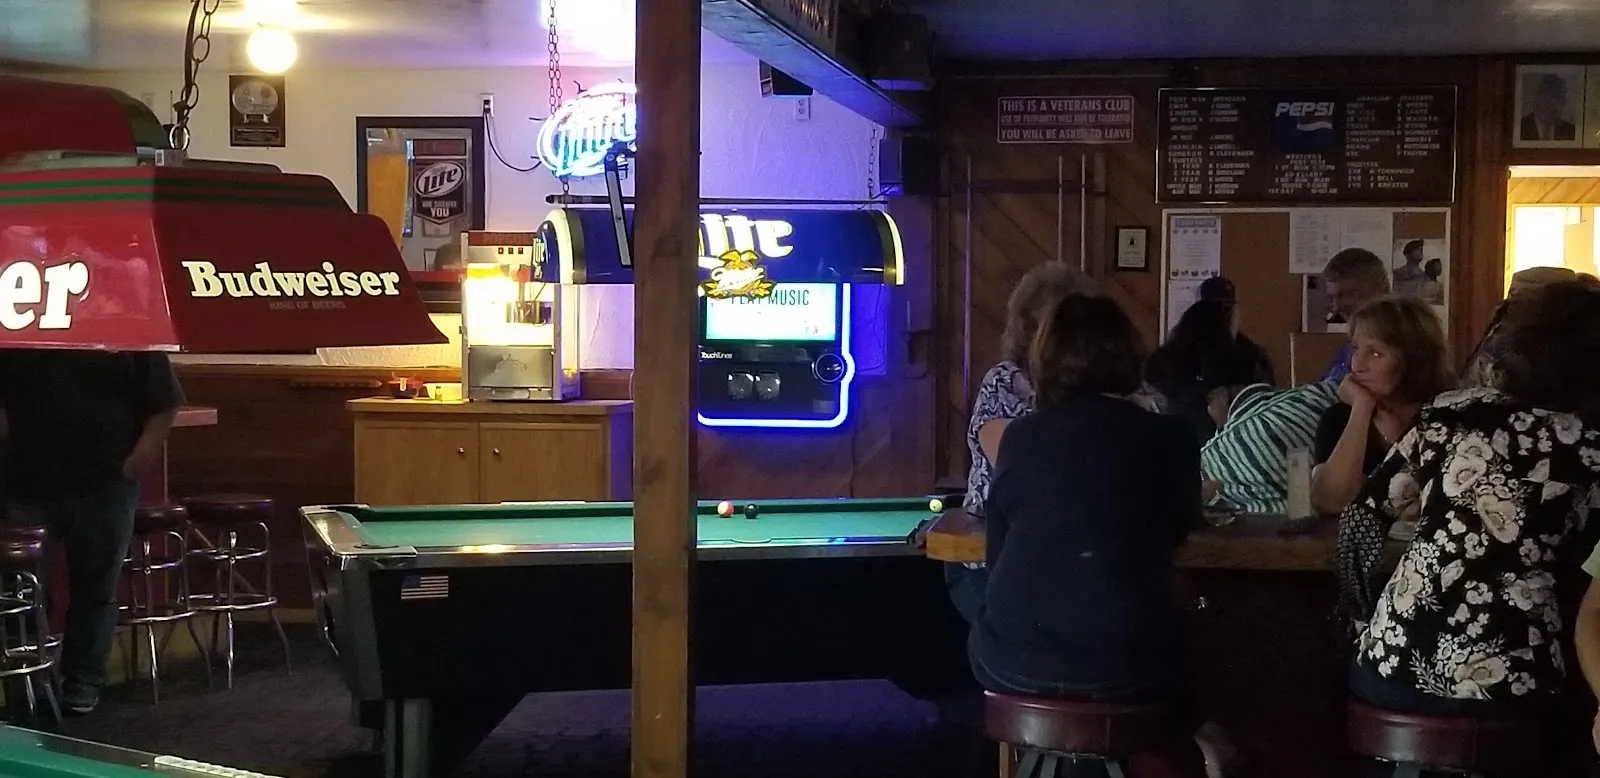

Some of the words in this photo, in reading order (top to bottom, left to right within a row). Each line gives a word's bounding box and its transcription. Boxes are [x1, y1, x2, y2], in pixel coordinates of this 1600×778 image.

[1002, 99, 1024, 111] THIS
[1028, 99, 1036, 111] IS
[1040, 99, 1047, 111] A
[1051, 99, 1102, 111] VETERANS
[1105, 99, 1130, 111] CLUB
[1274, 102, 1335, 117] PEPSI
[1013, 114, 1021, 123] OF
[1058, 114, 1073, 123] WILL
[1001, 129, 1020, 139] YOU
[1022, 129, 1043, 139] WILL
[1046, 129, 1057, 139] BE
[1091, 129, 1101, 139] TO
[1105, 129, 1131, 139] LEAVE
[422, 168, 459, 196] Lite
[430, 207, 450, 217] YOU
[698, 213, 794, 272] ite
[181, 261, 400, 298] Budweiser
[0, 261, 89, 330] er
[768, 289, 810, 306] MUSIC
[269, 300, 295, 310] KING
[296, 300, 310, 310] OF
[311, 300, 346, 310] BEERS
